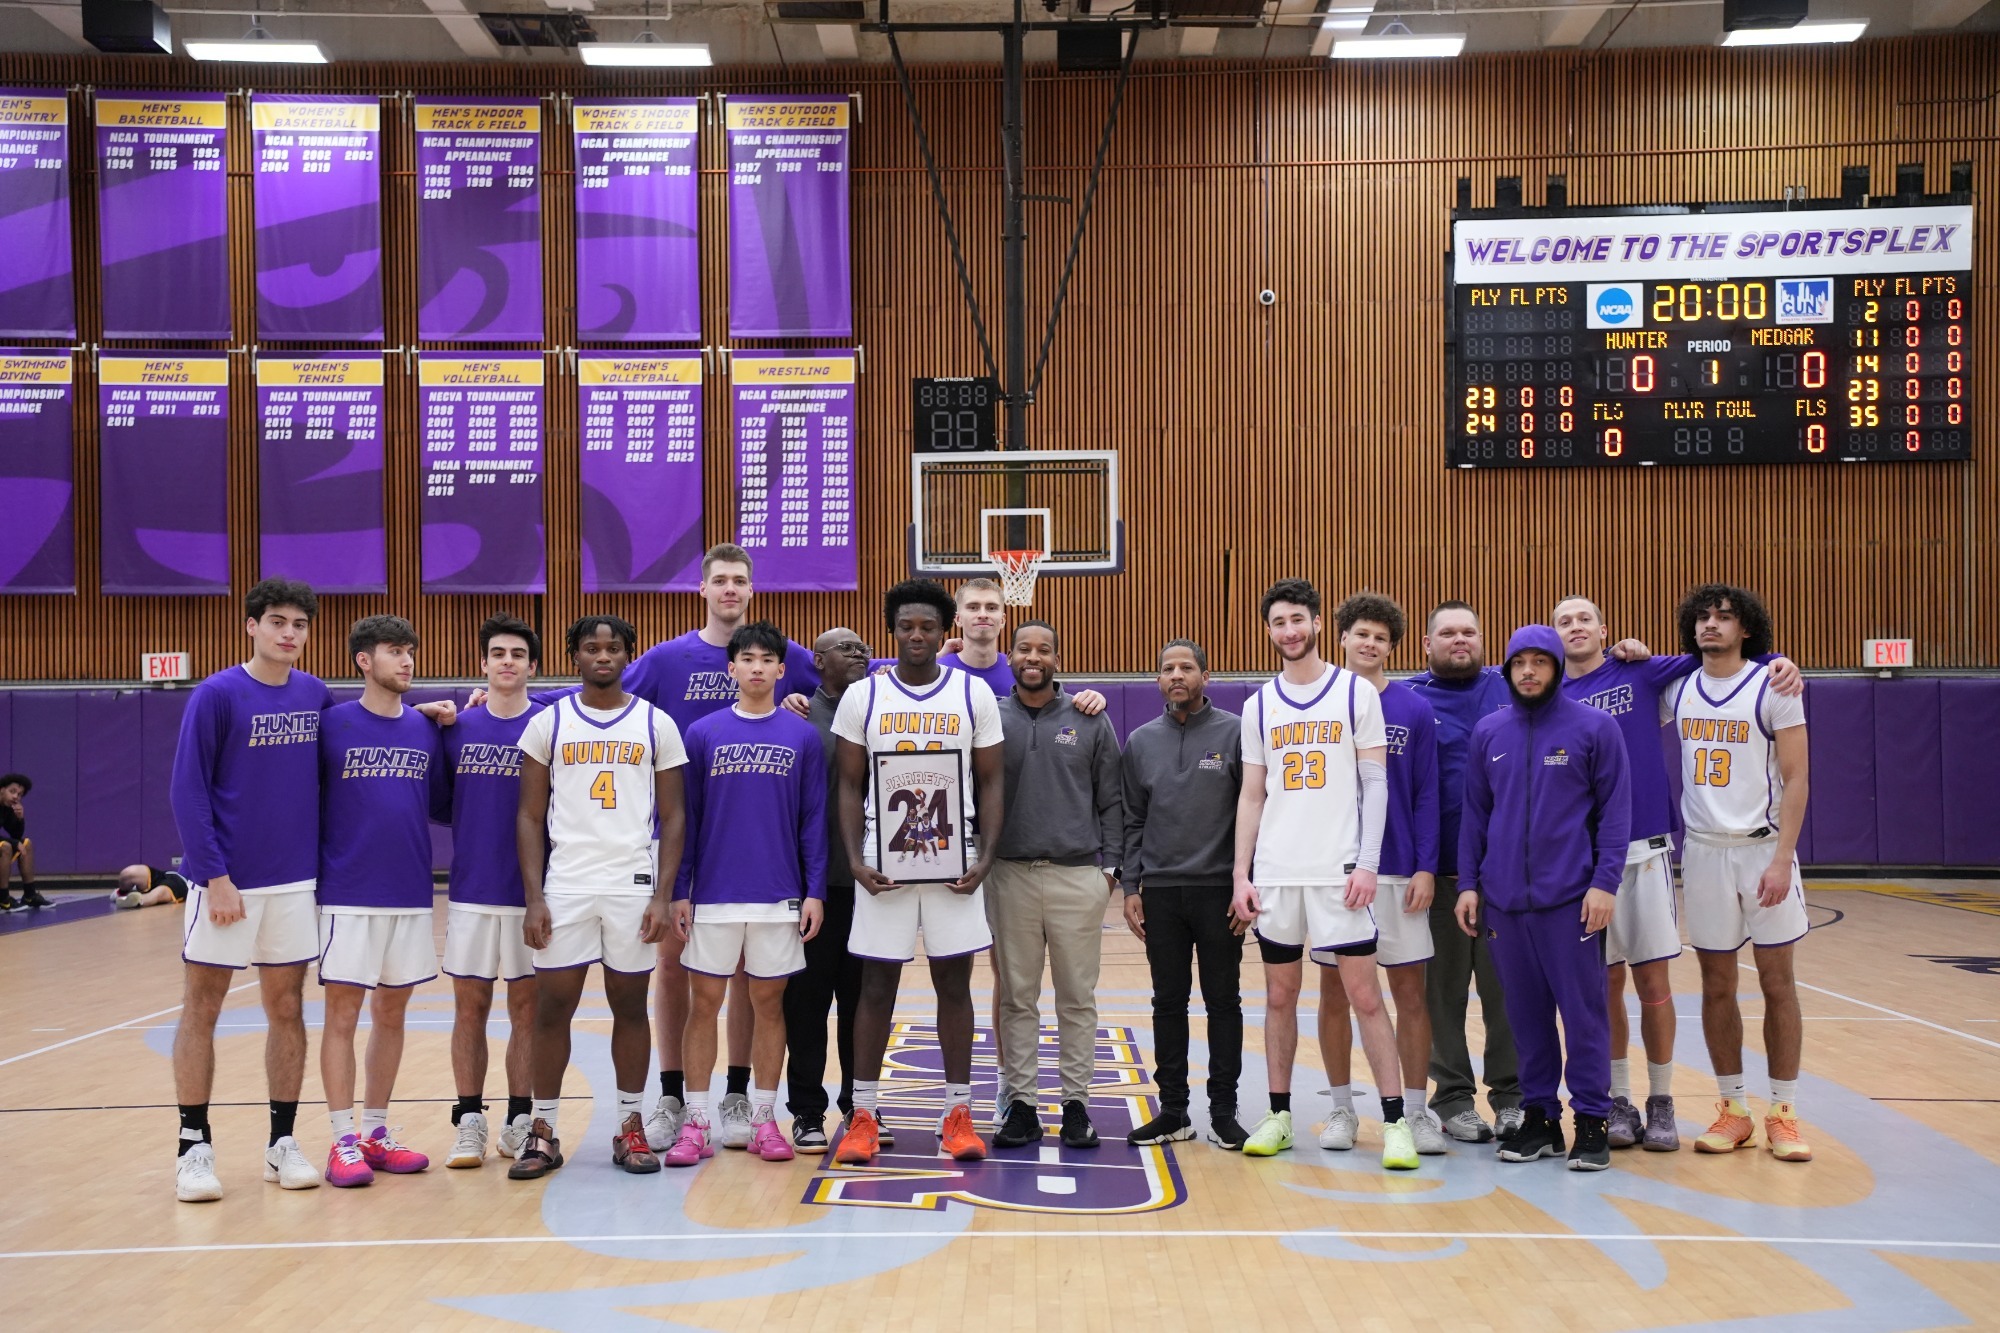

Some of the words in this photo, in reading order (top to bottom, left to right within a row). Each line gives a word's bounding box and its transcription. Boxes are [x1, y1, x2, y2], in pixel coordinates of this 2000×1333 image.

[141, 104, 182, 113] MEN'S
[288, 107, 346, 116] WOMEN'S
[432, 108, 471, 118] MEN'S
[474, 109, 524, 118] INDOOR
[582, 109, 638, 118] WOMEN'S
[641, 110, 690, 118] INDOOR
[739, 106, 775, 115] MEN'S
[780, 106, 837, 115] OUTDOOR
[118, 115, 204, 126] BASKETBALL
[274, 119, 357, 128] BASKETBALL
[432, 120, 473, 129] TRACK
[477, 121, 485, 129] &
[489, 121, 527, 129] FIELD
[590, 121, 630, 130] TRACK
[634, 122, 642, 130] &
[646, 121, 683, 130] FIELD
[742, 118, 782, 126] TRACK
[786, 118, 795, 126] &
[798, 118, 835, 126] FIELD
[109, 132, 139, 143] NCAA
[143, 133, 215, 145] TOURNAMENT
[265, 135, 294, 146] NCAA
[298, 135, 368, 147] TOURNAMENT
[423, 137, 451, 148] NCAA
[455, 138, 534, 148] CHAMPIONSHIP
[581, 138, 609, 148] NCAA
[613, 138, 691, 149] CHAMPIONSHIP
[734, 135, 761, 146] NCAA
[765, 135, 842, 145] CHAMPIONSHIP
[444, 151, 512, 162] APPEARANCE
[602, 152, 669, 162] APPEARANCE
[755, 148, 821, 159] APPEARANCE
[1465, 235, 1615, 265] WELCOME
[1621, 234, 1663, 262] TO
[1667, 232, 1733, 261] THE
[1734, 224, 1961, 259] SPORTSPLEX
[1854, 278, 1885, 297] PLY
[1895, 278, 1916, 296] FL
[1922, 276, 1956, 295] PTS
[1471, 288, 1501, 306] PLY
[1510, 288, 1530, 305] FL
[1535, 287, 1568, 305] PTS
[1653, 283, 1766, 322] 20:00
[1599, 305, 1632, 316] NCAA
[1864, 301, 1879, 323] 2
[1906, 300, 1920, 321] 0
[1947, 299, 1961, 320] 0
[1606, 331, 1668, 350] HUNTER
[1751, 327, 1814, 346] MEDGAR
[1906, 326, 1920, 347] 0
[1947, 325, 1961, 346] 0
[1687, 340, 1731, 353] PERIOD
[4, 360, 67, 369] SWIMMING
[144, 362, 184, 371] MEN'S
[293, 363, 350, 372] WOMEN'S
[462, 363, 501, 372] MEN'S
[613, 362, 669, 371] WOMEN'S
[1856, 355, 1879, 373] 14
[1906, 352, 1920, 374] 0
[1947, 351, 1961, 372] 0
[758, 367, 830, 376] WRESTLING
[1632, 355, 1653, 392] 0
[1712, 360, 1719, 385] 1
[1803, 351, 1825, 388] 0
[141, 373, 189, 383] TENNIS
[298, 374, 345, 384] TENNIS
[443, 374, 521, 383] VOLLEYBALL
[602, 374, 679, 382] VOLLEYBALL
[739, 390, 767, 400] NCAA
[770, 389, 848, 400] CHAMPIONSHIP
[1848, 379, 1879, 401] 23
[1906, 378, 1920, 400] 0
[1947, 377, 1961, 399] 0
[112, 390, 141, 401] NCAA
[145, 390, 217, 402] TOURNAMENT
[269, 391, 298, 402] NCAA
[302, 391, 372, 402] TOURNAMENT
[429, 391, 462, 402] NECVA
[466, 391, 535, 402] TOURNAMENT
[591, 390, 619, 401] NCAA
[623, 390, 691, 401] TOURNAMENT
[1465, 387, 1495, 409] 23
[1520, 386, 1534, 408] 0
[1559, 386, 1573, 407] 0
[106, 404, 135, 415] 2010
[150, 404, 176, 415] 2011
[192, 404, 220, 415] 2015
[265, 405, 293, 416] 2007
[761, 403, 826, 414] APPEARANCE
[1796, 399, 1827, 417] FLS
[1850, 405, 1879, 427] 35
[1906, 404, 1920, 426] 0
[1947, 403, 1961, 425] 0
[107, 416, 135, 427] 2016
[265, 417, 292, 428] 2010
[307, 417, 333, 428] 2011
[349, 417, 376, 428] 2012
[1466, 413, 1495, 435] 24
[1520, 412, 1534, 433] 0
[1560, 412, 1573, 433] 0
[265, 429, 293, 440] 2013
[305, 429, 334, 440] 2022
[347, 429, 375, 440] 2024
[627, 428, 654, 439] 2014
[668, 428, 695, 438] 2015
[1807, 424, 1825, 453] 0
[627, 440, 655, 451] 2017
[1604, 428, 1622, 457] 0
[1906, 430, 1920, 452] 0
[1521, 438, 1534, 459] 0
[625, 452, 653, 463] 2022
[433, 460, 460, 471] NCAA
[465, 460, 534, 471] TOURNAMENT
[427, 474, 454, 484] 2012
[510, 473, 537, 484] 2017
[741, 525, 766, 536] 2011
[781, 524, 808, 535] 2012
[822, 524, 848, 534] 2013
[741, 537, 768, 547] 2014
[781, 537, 809, 547] 2015
[1875, 642, 1907, 664] EXIT
[150, 656, 181, 678] EXIT
[251, 711, 320, 738] HUNTER
[879, 712, 961, 736] HUNTER
[1270, 720, 1343, 751] HUNTER
[1681, 717, 1750, 744] HUNTER
[562, 740, 645, 766] HUNTER
[712, 743, 796, 769] HUNTER
[344, 746, 430, 772] HUNTER
[710, 764, 789, 777] BASKETBALL
[1282, 750, 1326, 791] 23
[1693, 747, 1732, 788] 13
[341, 768, 424, 780] BASKETBALL
[885, 772, 955, 794] JARRETT
[590, 770, 617, 810] 4
[887, 788, 954, 852] 24
